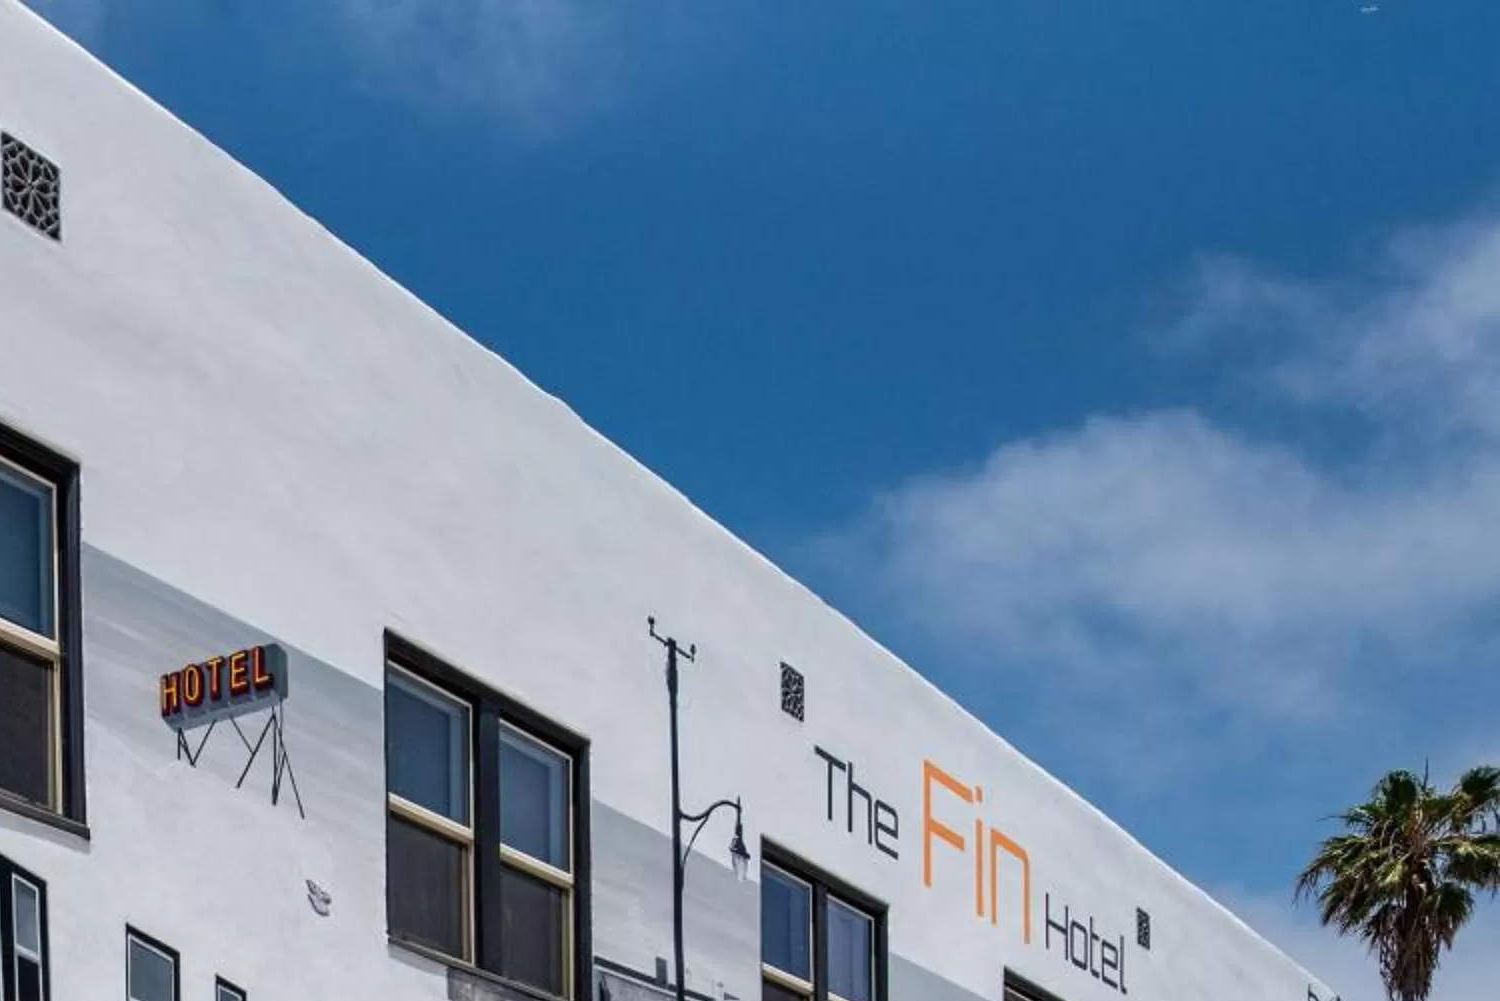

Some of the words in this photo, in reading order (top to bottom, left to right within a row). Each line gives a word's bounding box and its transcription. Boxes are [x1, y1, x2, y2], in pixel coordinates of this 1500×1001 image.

[160, 646, 273, 717] HOTEL
[814, 745, 899, 860] The
[923, 759, 1031, 945] Fin
[1045, 892, 1128, 995] Hotel
